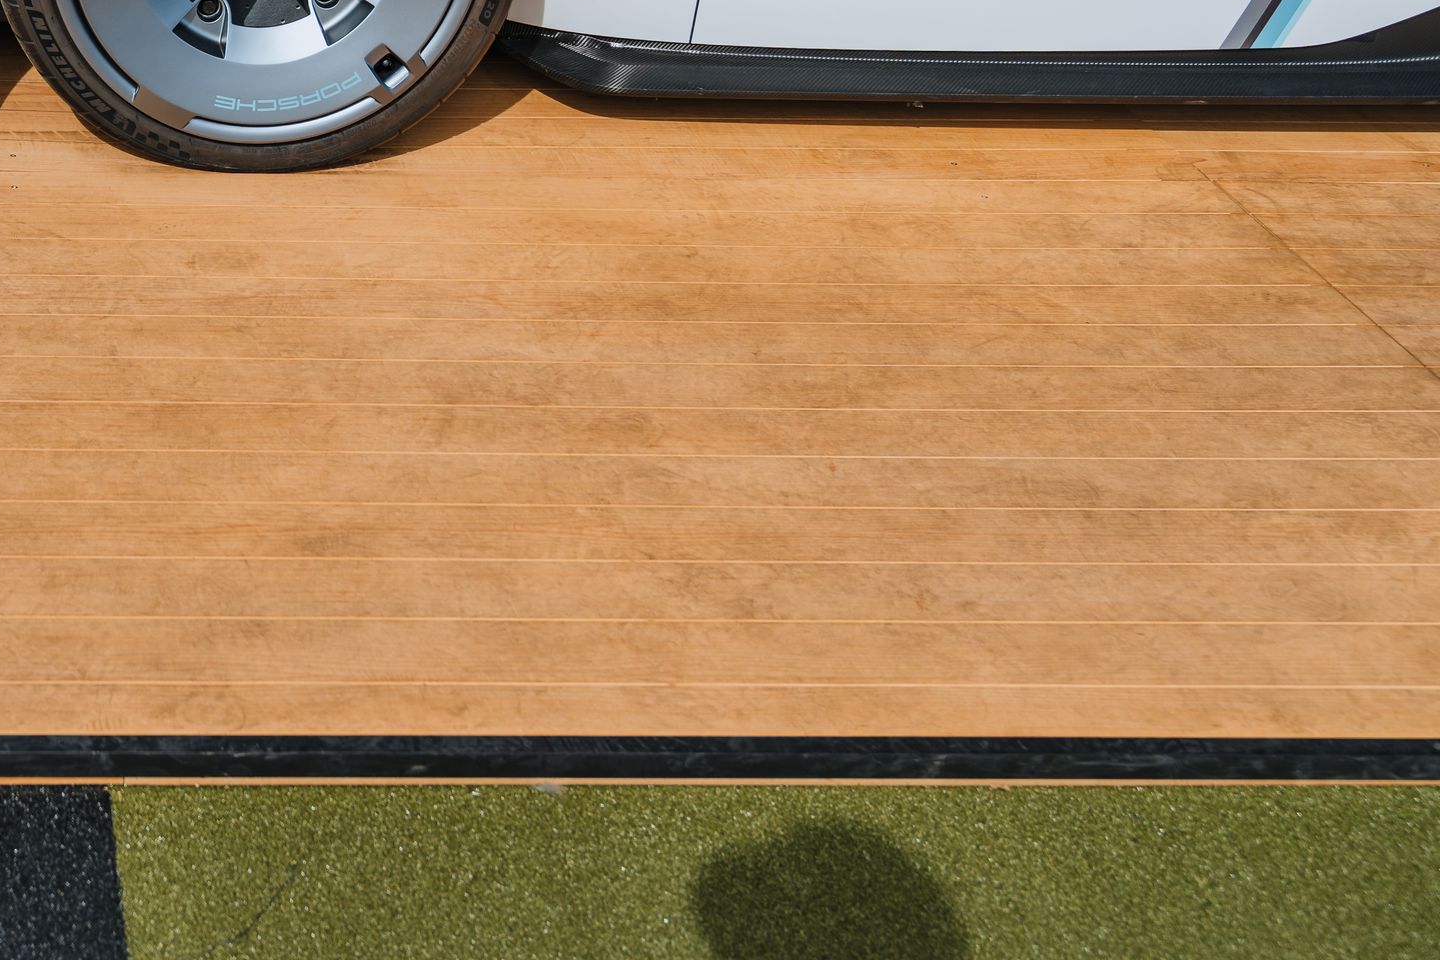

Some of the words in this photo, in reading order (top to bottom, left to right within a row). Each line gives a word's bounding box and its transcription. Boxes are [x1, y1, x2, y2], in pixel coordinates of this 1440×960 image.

[483, 0, 496, 19] 20
[31, 18, 113, 114] MICHELIN
[214, 71, 363, 112] PORSCHE
